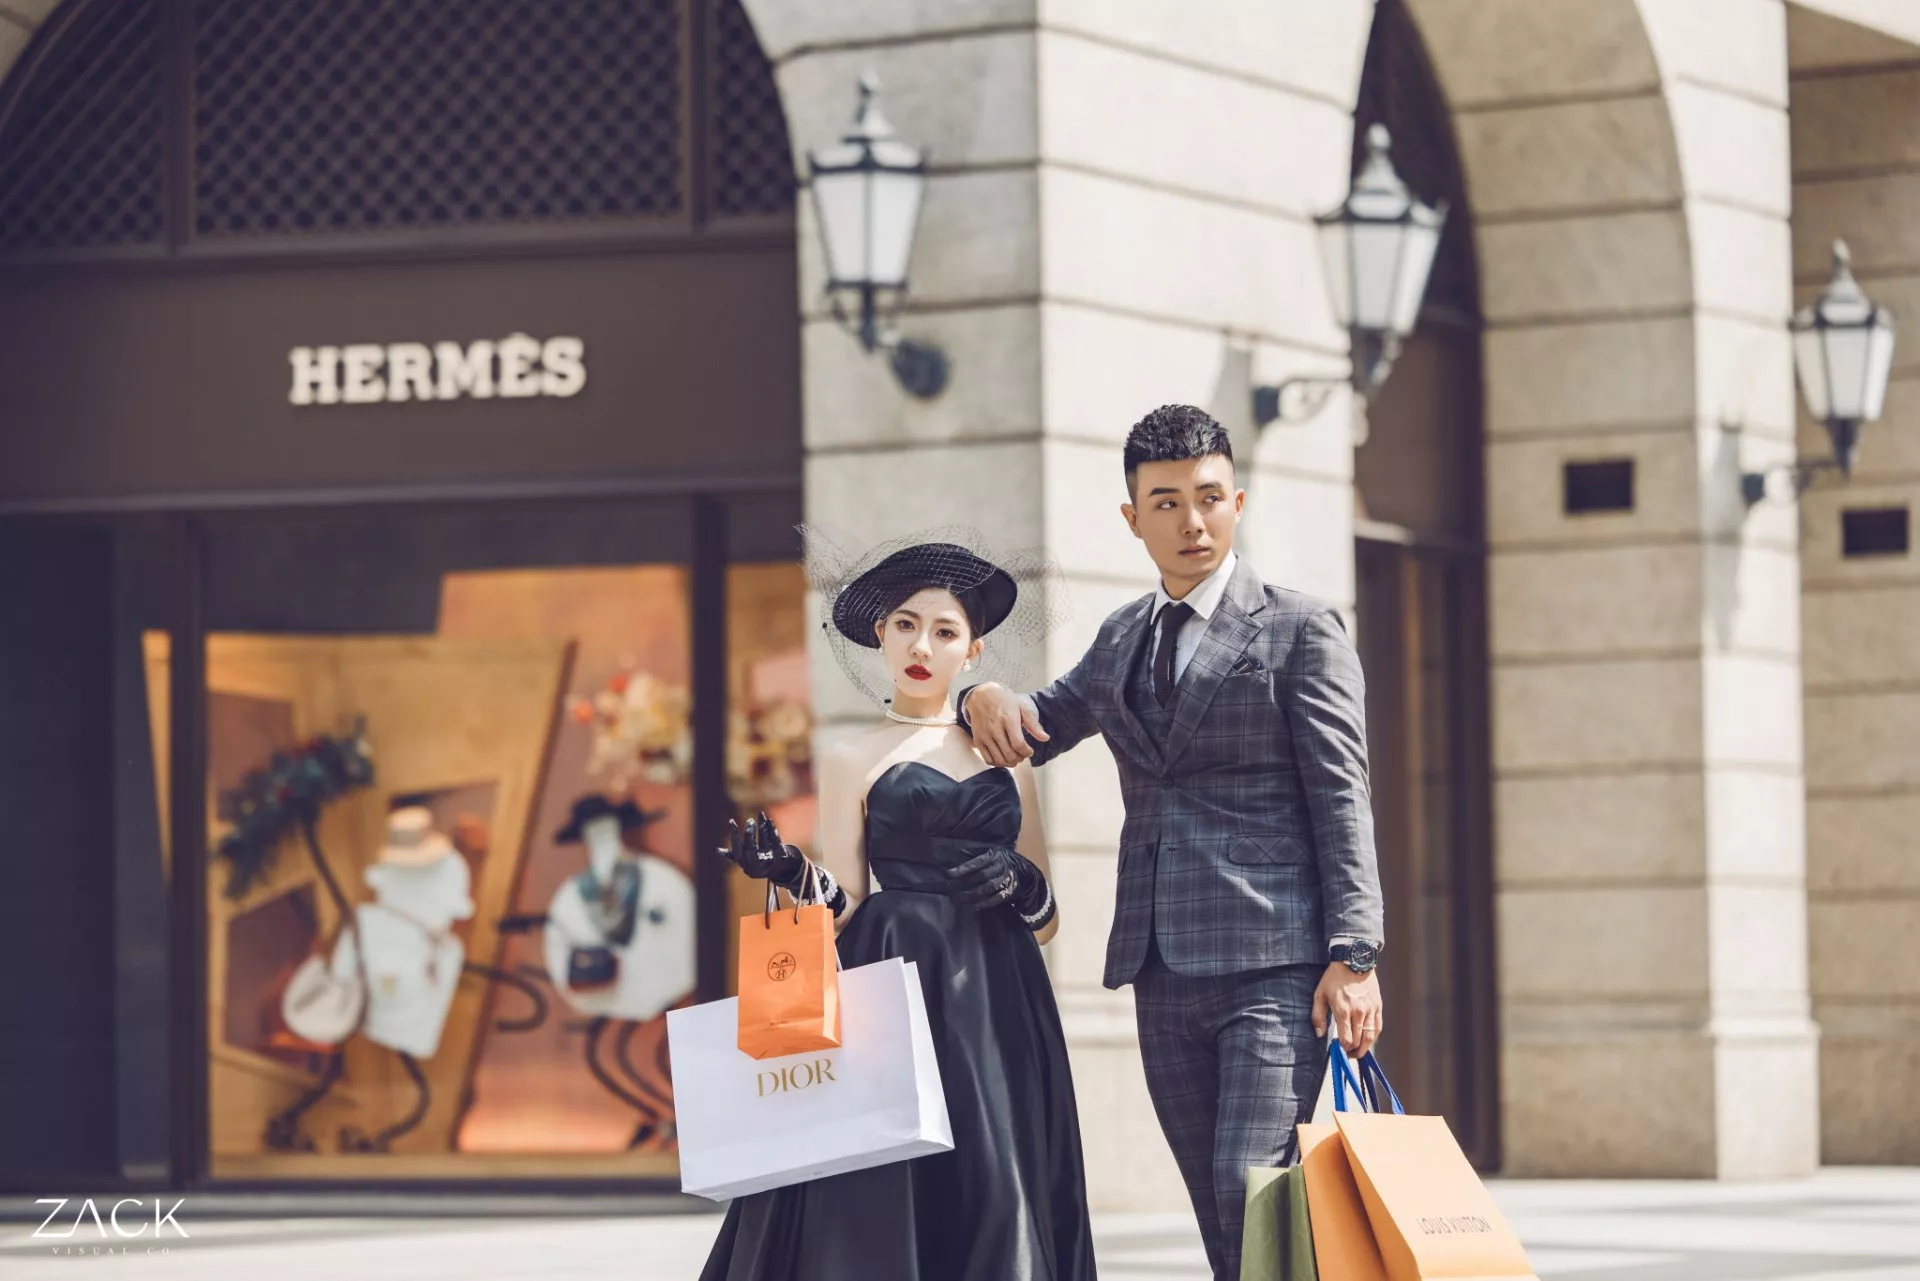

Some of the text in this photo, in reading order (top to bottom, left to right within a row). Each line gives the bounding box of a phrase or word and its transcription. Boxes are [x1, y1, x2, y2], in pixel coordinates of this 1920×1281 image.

[757, 1058, 836, 1097] DIOR
[1415, 1215, 1492, 1235] LOUIS VUITTON
